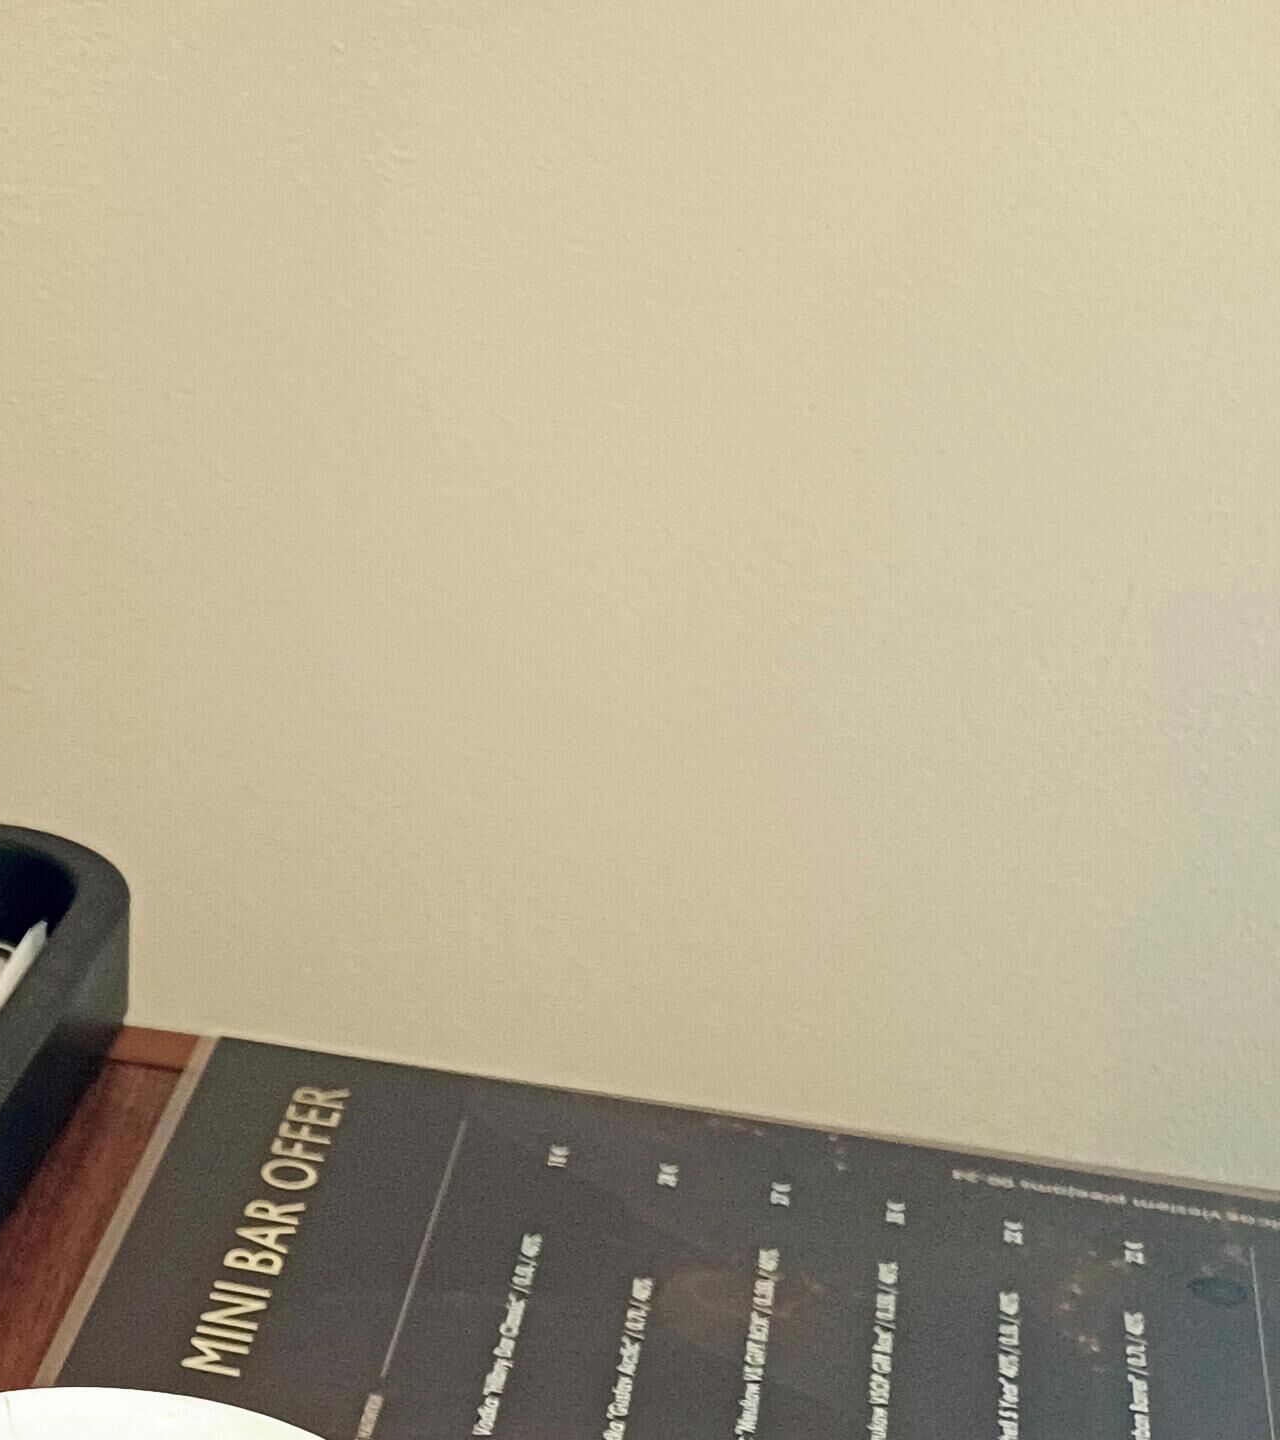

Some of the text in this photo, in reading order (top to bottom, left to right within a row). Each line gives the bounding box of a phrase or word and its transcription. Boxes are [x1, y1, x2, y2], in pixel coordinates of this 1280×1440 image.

[181, 1086, 350, 1377] MINI BAR OFFER
